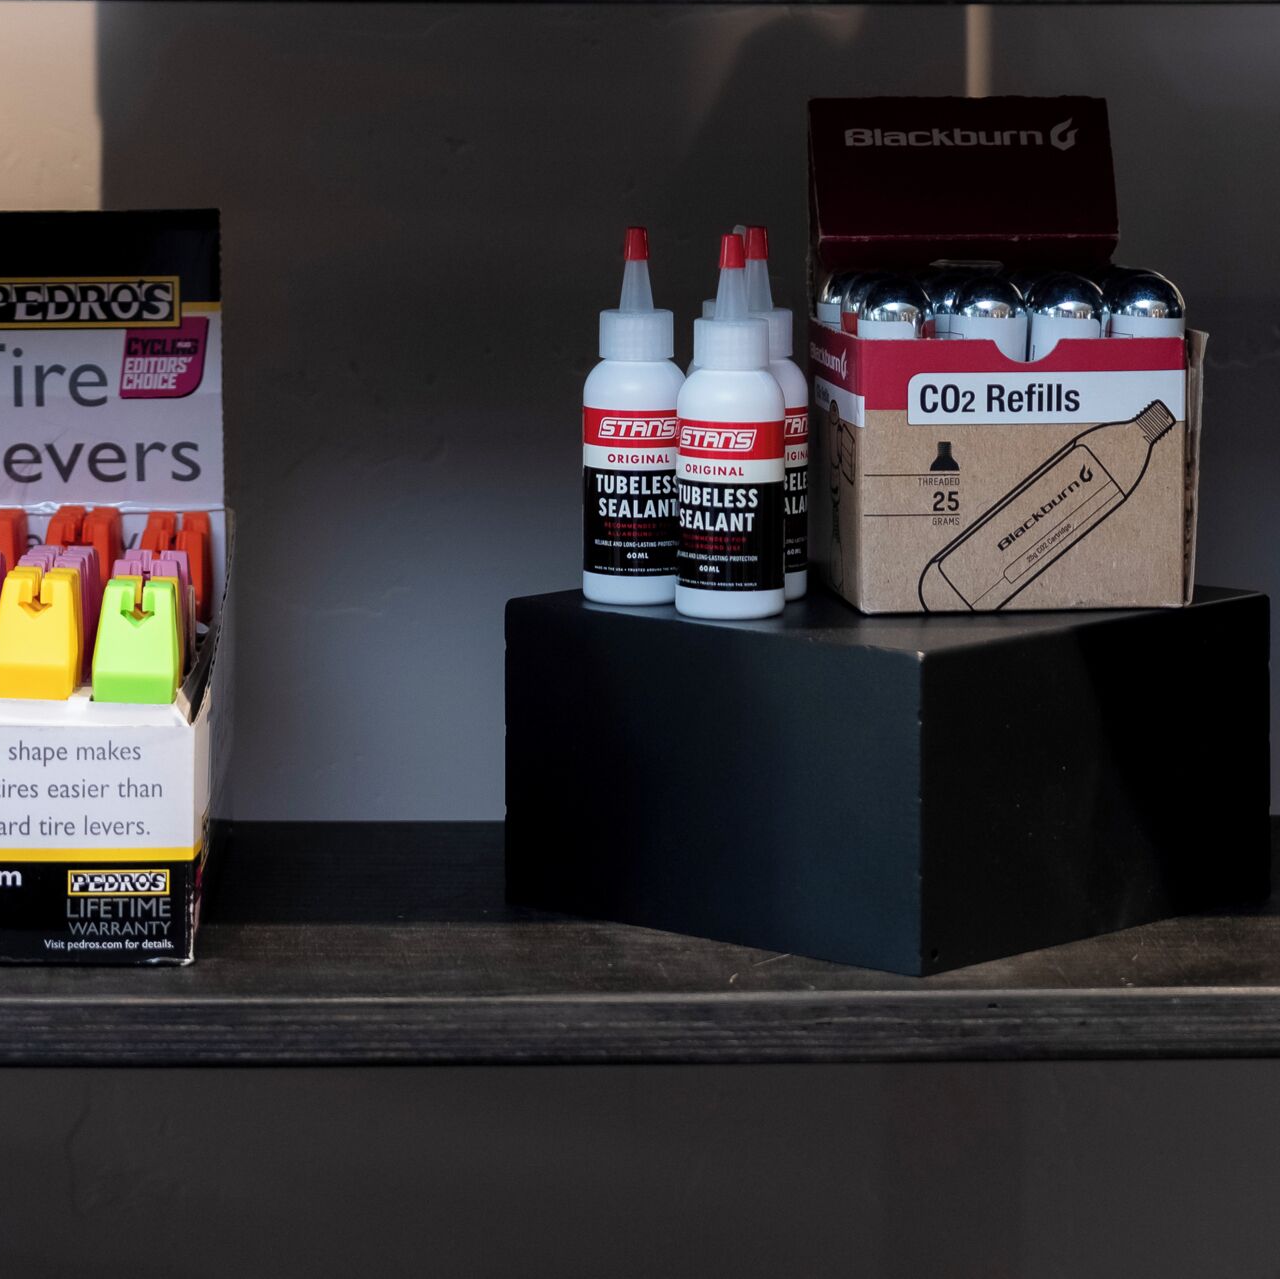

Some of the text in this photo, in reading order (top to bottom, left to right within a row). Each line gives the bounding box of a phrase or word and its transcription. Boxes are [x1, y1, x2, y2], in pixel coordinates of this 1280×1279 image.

[844, 128, 1043, 148] Blackburn
[124, 357, 192, 373] EDITORS'
[122, 374, 177, 389] CHOICE
[920, 383, 1080, 414] CO2 Refills
[685, 464, 744, 477] ORIGINAL
[918, 477, 960, 486] THREADED
[679, 484, 758, 508] TUBELESS
[932, 491, 960, 512] 25
[680, 508, 755, 532] SEALANT
[932, 516, 960, 526] GRAMS
[997, 480, 1080, 551] Blackburn
[8, 740, 68, 767] shape
[76, 740, 141, 761] makes
[47, 779, 109, 799] easier
[118, 777, 163, 798] than
[39, 816, 76, 836] tire
[84, 816, 151, 836] levers.
[72, 872, 167, 892] PEDRO'S
[67, 898, 171, 919] LIFETIME
[68, 921, 171, 936] WARRANTY
[44, 939, 175, 951] Visit pedros.com for details.
